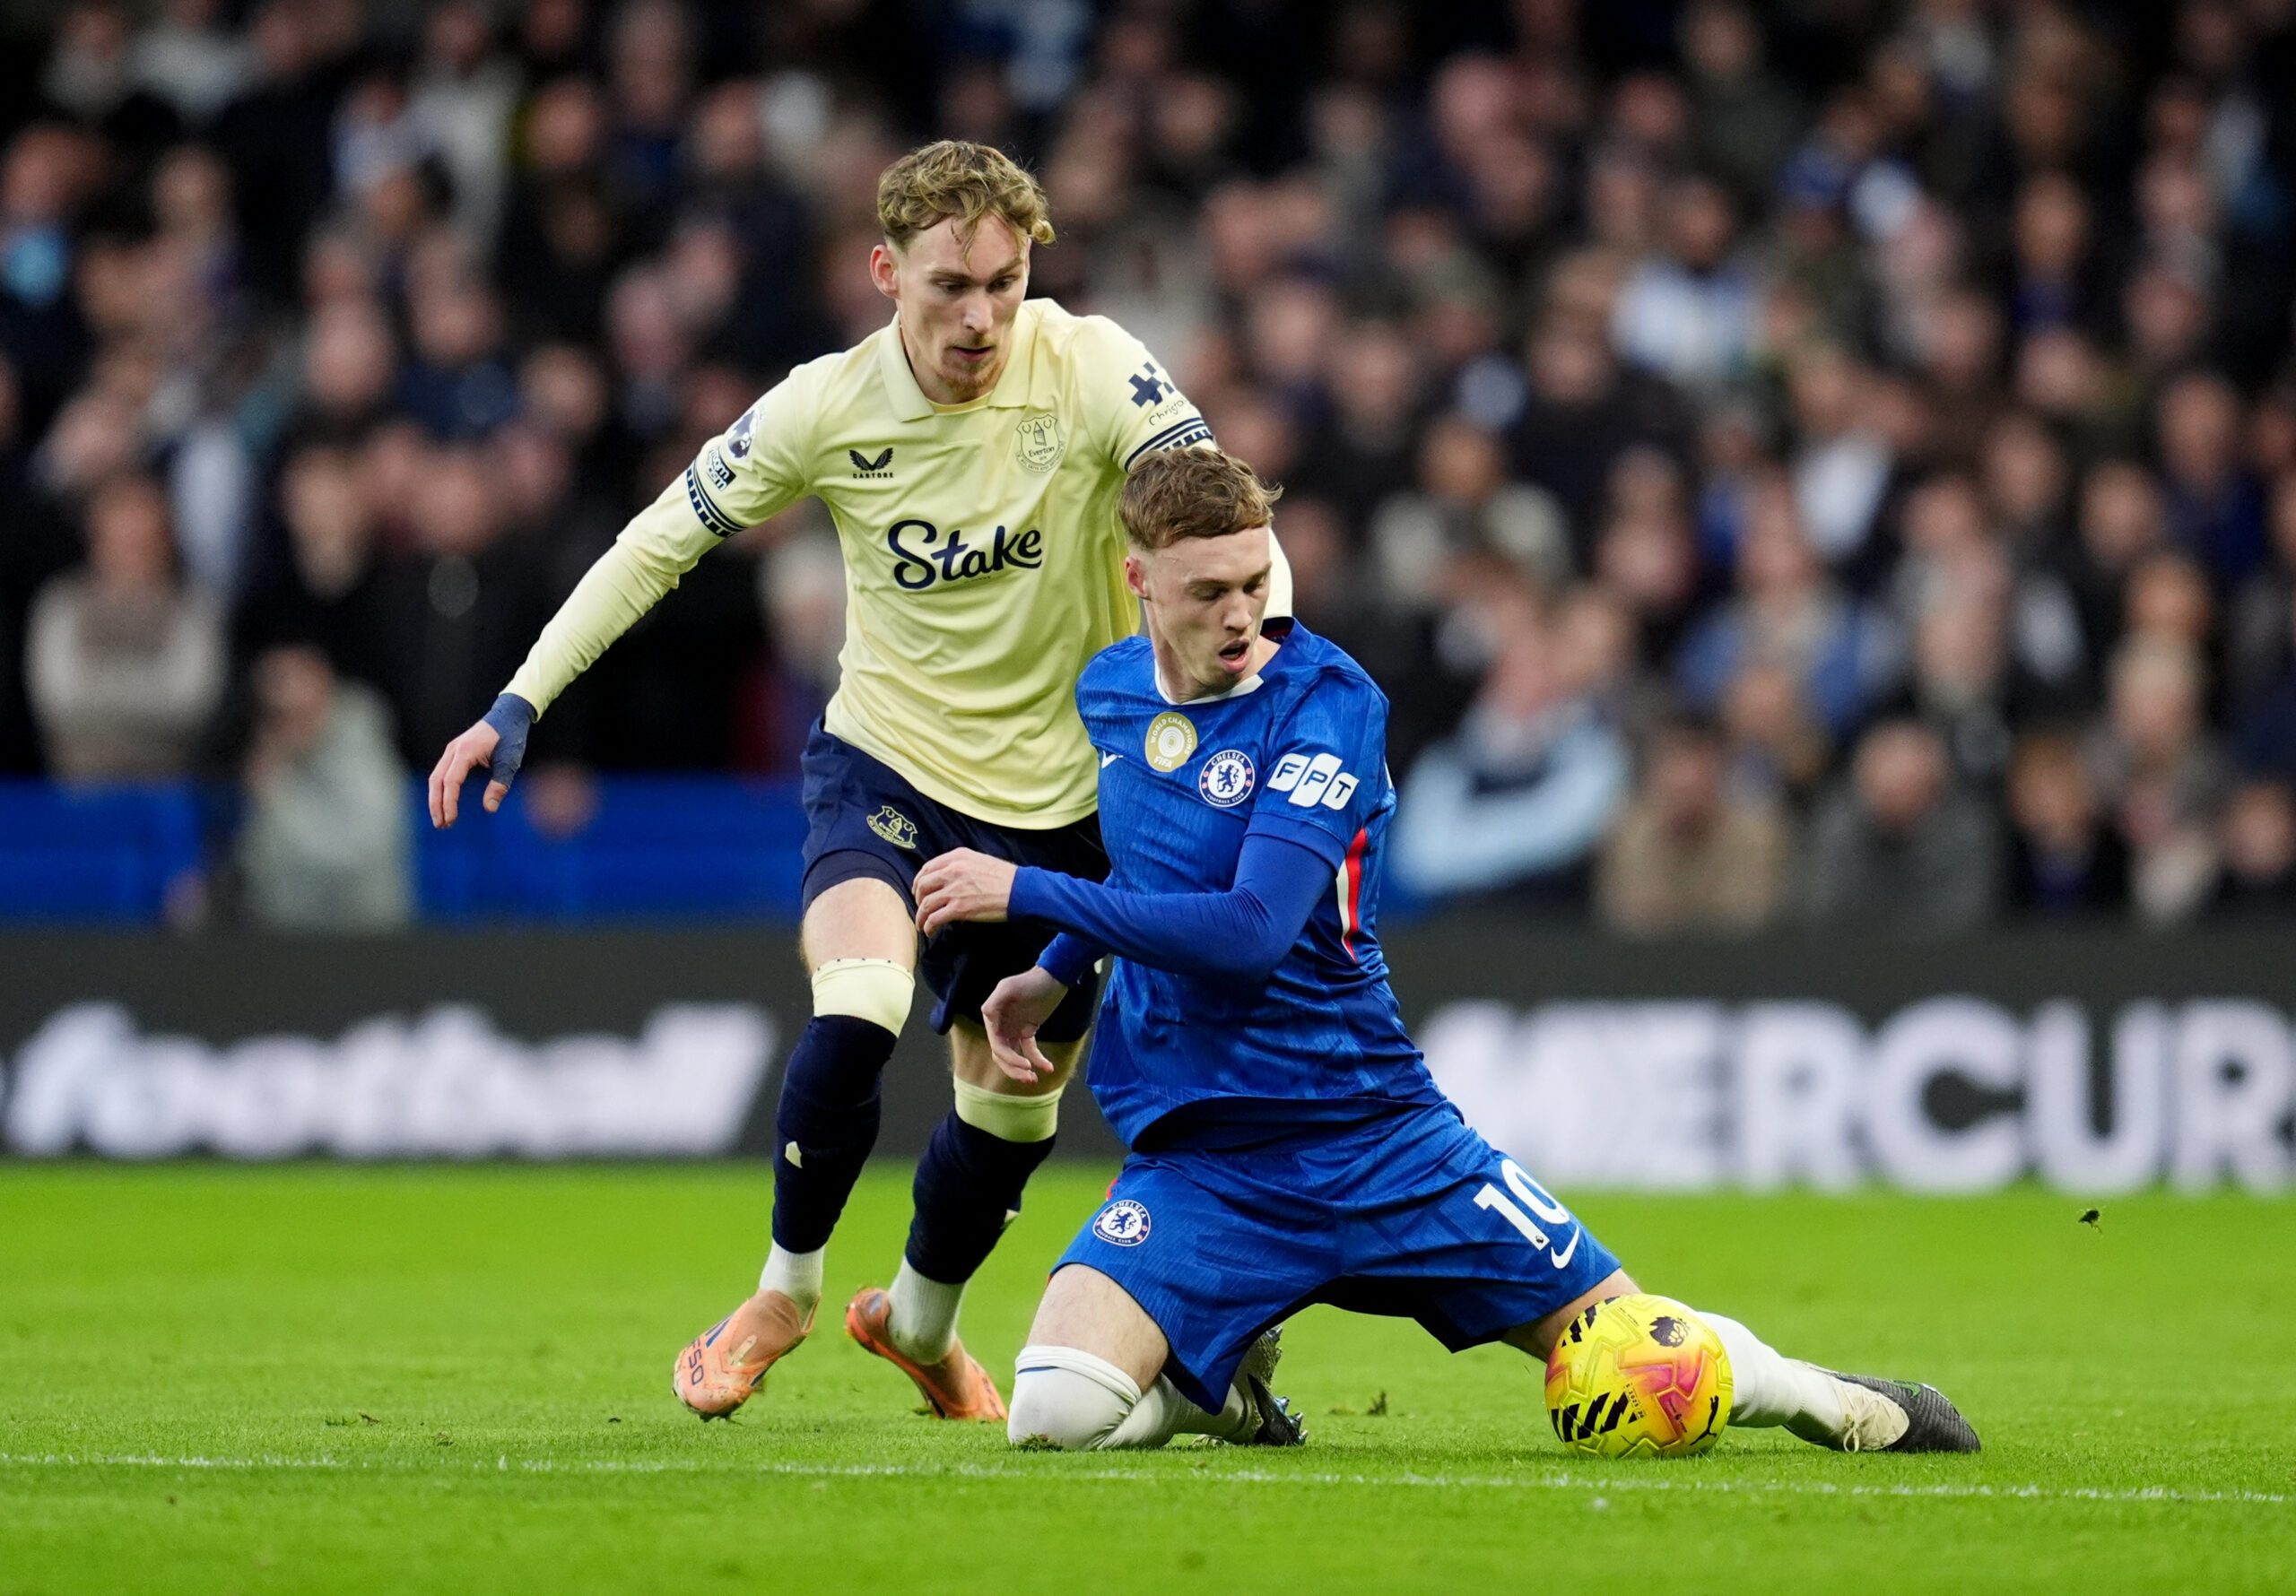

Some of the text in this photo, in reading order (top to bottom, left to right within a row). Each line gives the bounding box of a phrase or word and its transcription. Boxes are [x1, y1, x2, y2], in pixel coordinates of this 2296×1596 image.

[1148, 399, 1186, 426] Christo
[1028, 447, 1055, 457] Everton
[887, 519, 1042, 590] Stake
[1151, 717, 1193, 755] WORLD CHAMPIONS
[1154, 756, 1172, 768] FIFA
[1211, 752, 1245, 767] CHELSEA
[1275, 761, 1352, 799] FPT
[1112, 1201, 1147, 1219] CHELSEA
[1473, 1158, 1570, 1251] 10
